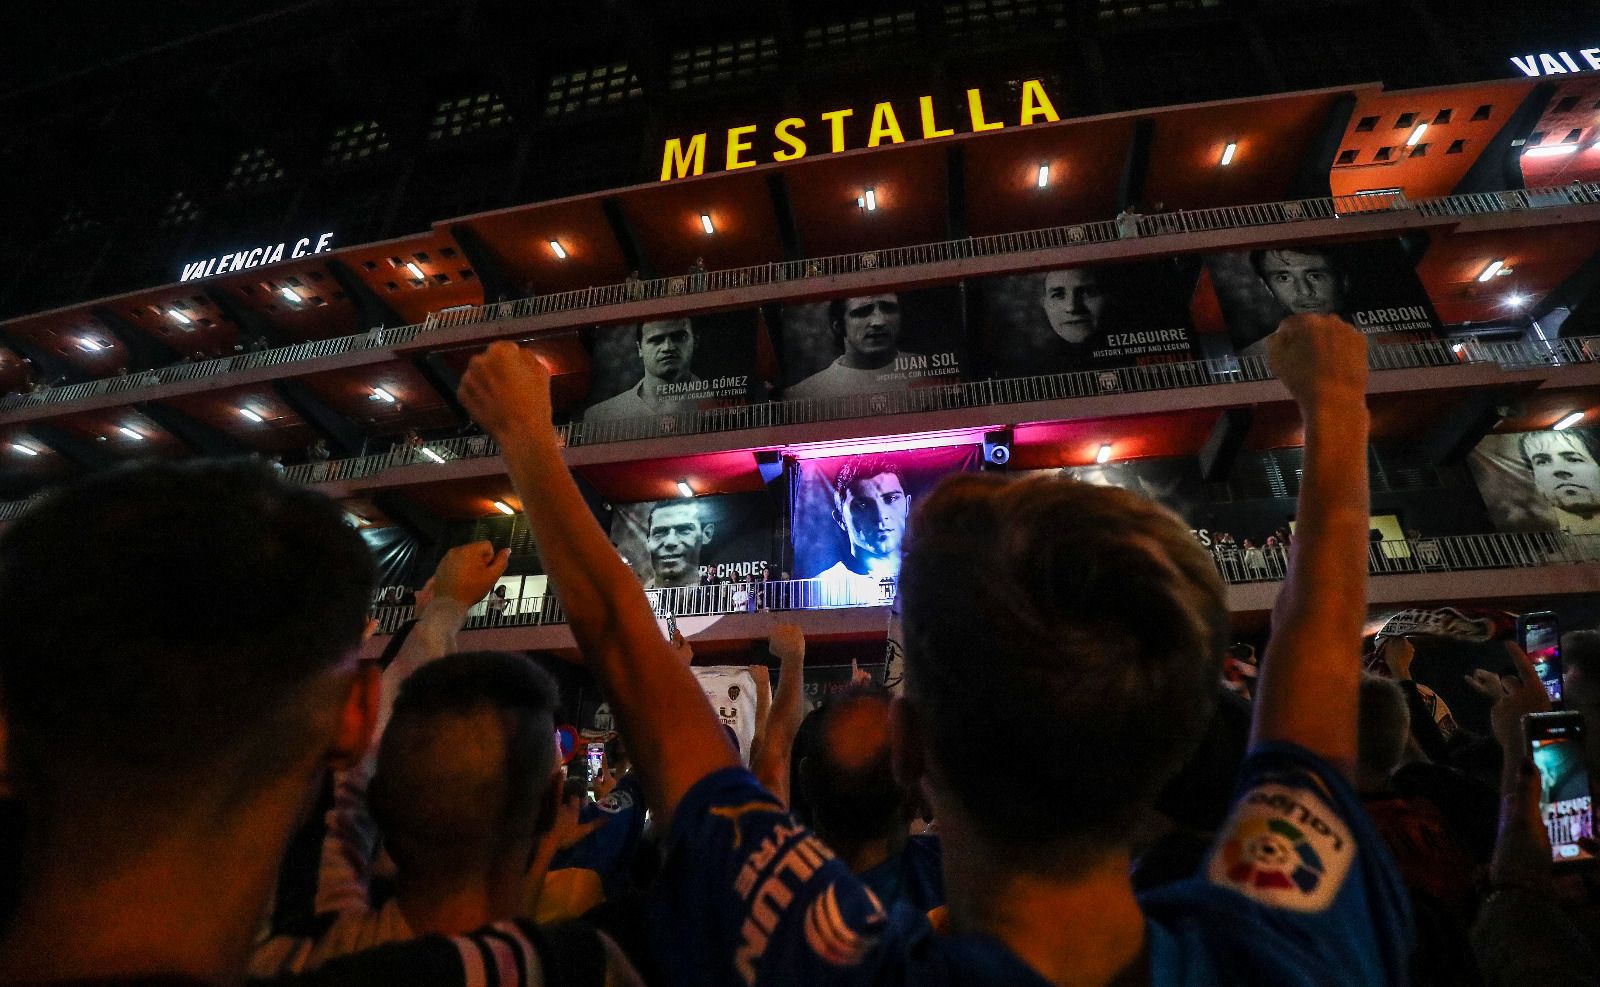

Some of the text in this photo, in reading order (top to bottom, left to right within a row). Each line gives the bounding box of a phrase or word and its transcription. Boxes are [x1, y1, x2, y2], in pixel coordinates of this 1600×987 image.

[660, 79, 1060, 182] MESTALLA
[180, 243, 284, 282] VALENCIA
[1356, 305, 1428, 325] CARBONI
[1107, 328, 1188, 347] EIZAGUIRRE
[1124, 345, 1146, 355] HEART
[1148, 345, 1162, 353] AND
[1163, 342, 1190, 351] LEGEND
[893, 352, 959, 372] JUAN SOL
[656, 375, 748, 395] FERNANDO GÓMEZ
[698, 561, 767, 578] PCHADES
